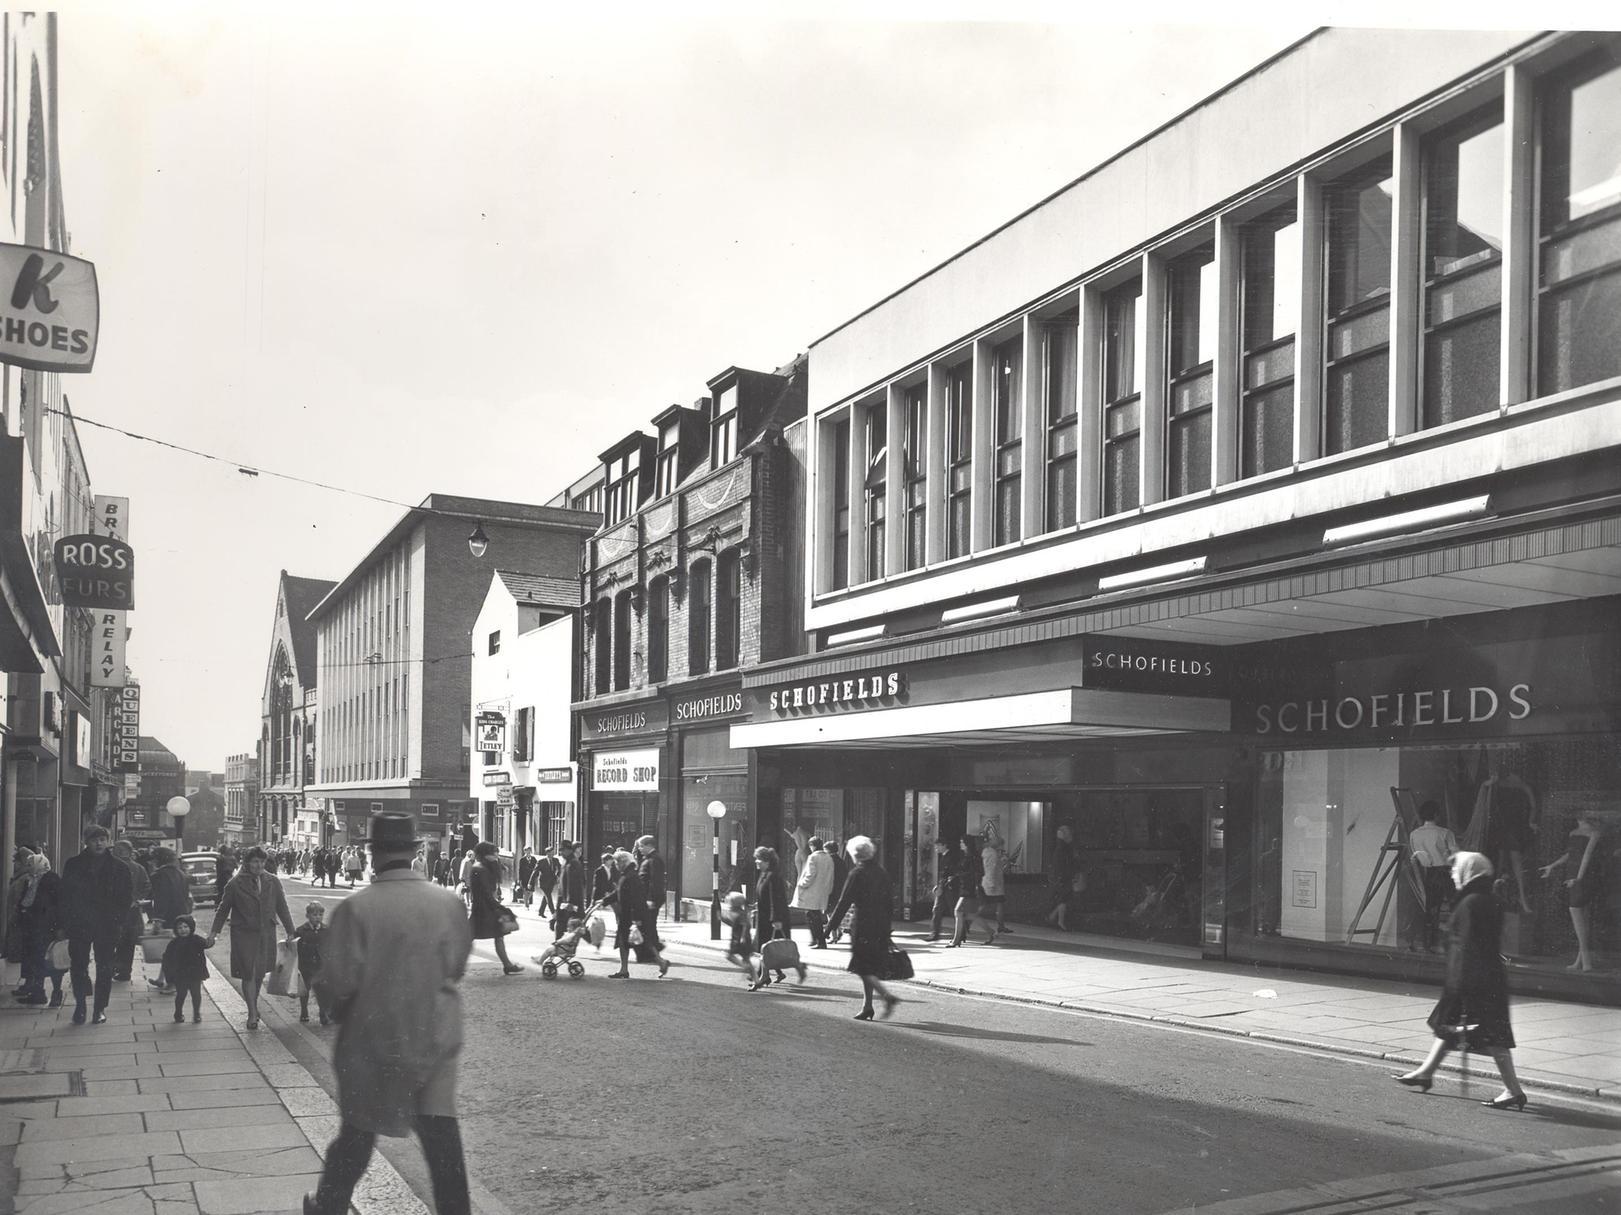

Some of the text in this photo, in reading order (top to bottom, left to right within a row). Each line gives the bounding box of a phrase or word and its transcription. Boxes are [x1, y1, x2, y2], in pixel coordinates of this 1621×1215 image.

[11, 253, 65, 314] K
[0, 316, 89, 354] HOES
[63, 542, 127, 570] ROSS
[63, 577, 127, 599] FURS
[101, 614, 116, 679] RELAY
[1095, 651, 1212, 676] SCHOFIELDS
[769, 672, 899, 711] SCHOFIELDS
[676, 692, 742, 720] SCHOFIELDS
[1256, 683, 1531, 734] SCHOFIELDS
[113, 693, 122, 768] ARCADE
[123, 689, 138, 761] QUEENS
[597, 711, 647, 733] SCHOFIELDS
[479, 741, 502, 750] TETLEY
[597, 766, 657, 783] RECORD SHOP
[603, 757, 628, 766] Schofields
